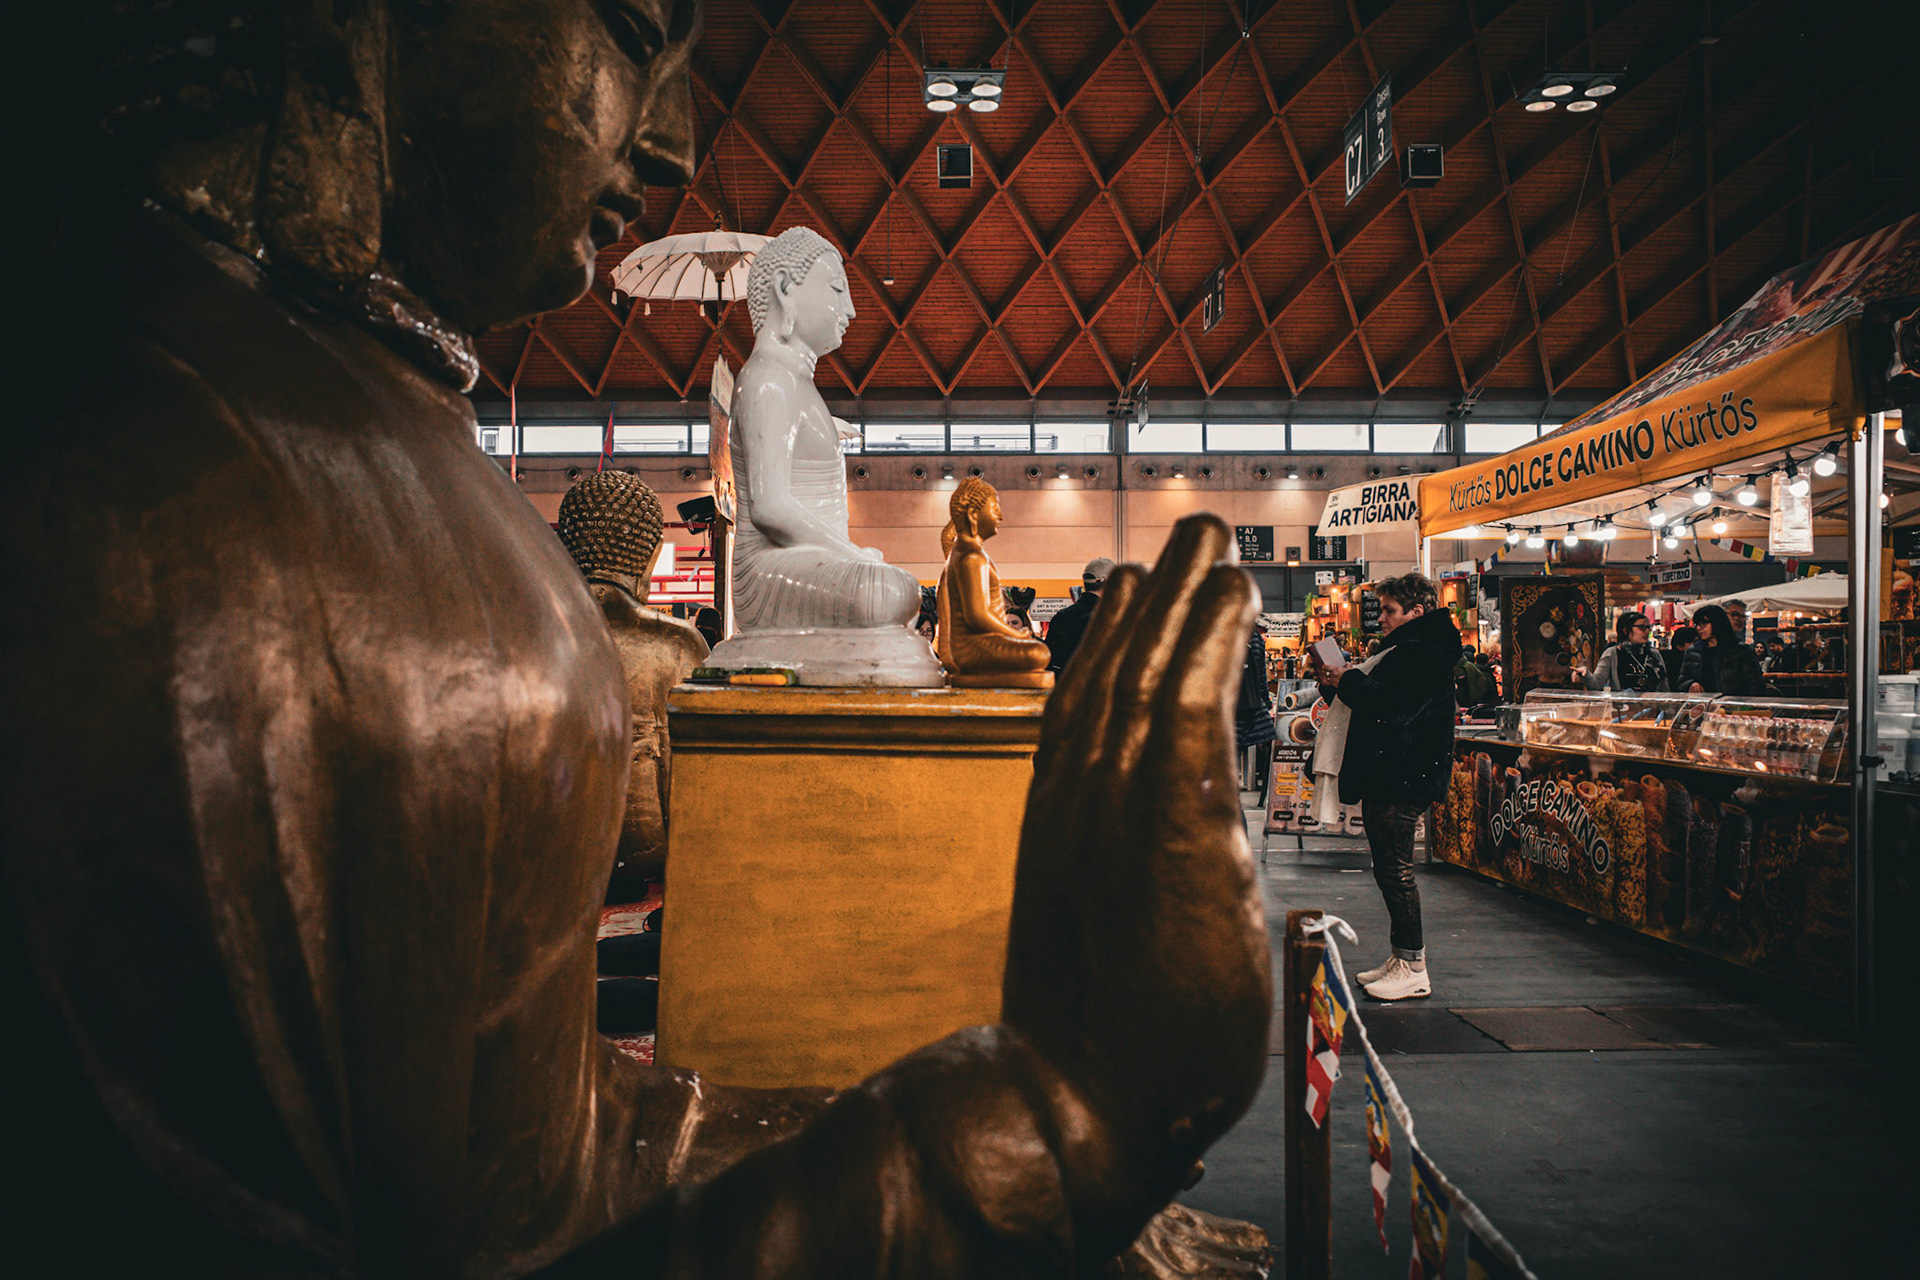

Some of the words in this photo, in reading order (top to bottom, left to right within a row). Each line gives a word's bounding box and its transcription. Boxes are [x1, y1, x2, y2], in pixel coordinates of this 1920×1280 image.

[1345, 134, 1363, 197] C7
[1377, 127, 1385, 161] 3
[1494, 451, 1554, 501] DOLCE
[1556, 419, 1655, 483] CAMINO
[1661, 390, 1758, 453] Kürtős
[1327, 500, 1417, 528] ARTIGIANA
[1361, 481, 1410, 506] BIRRA
[1490, 780, 1541, 847] DOLCE
[1540, 780, 1610, 875] CAMINO
